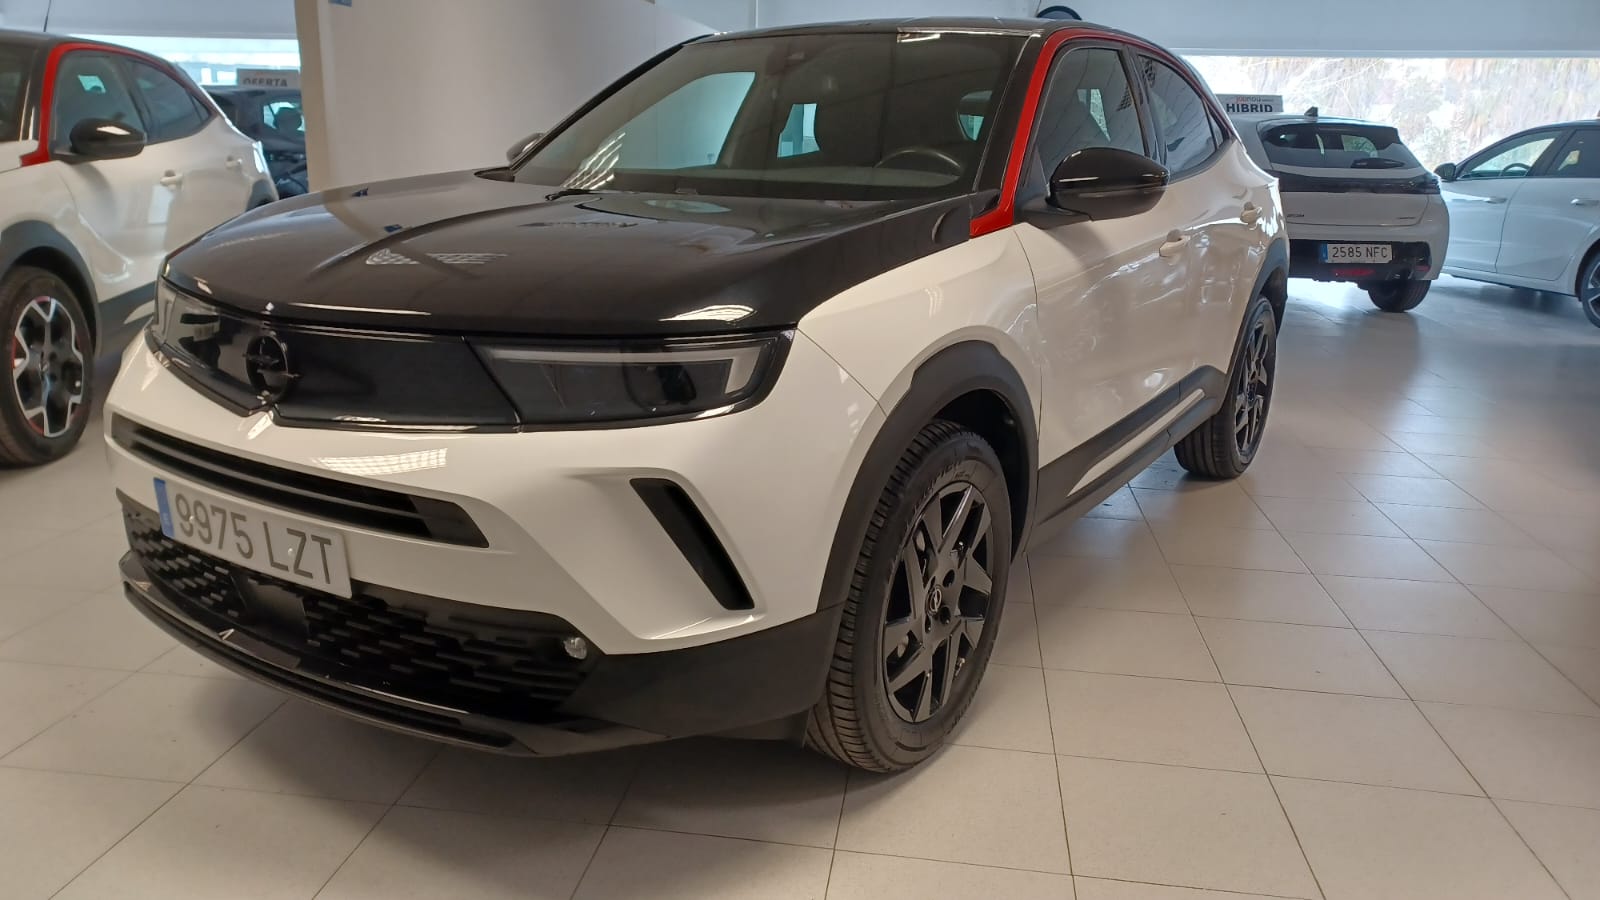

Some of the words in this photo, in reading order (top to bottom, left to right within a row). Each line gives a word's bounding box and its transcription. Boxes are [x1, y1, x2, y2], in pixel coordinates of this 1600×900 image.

[242, 77, 288, 87] OFERTA
[1226, 103, 1273, 112] HIBRID
[1332, 246, 1362, 258] 2585
[1366, 246, 1388, 258] NFC
[175, 493, 254, 559] 9975
[263, 521, 332, 584] LZT
